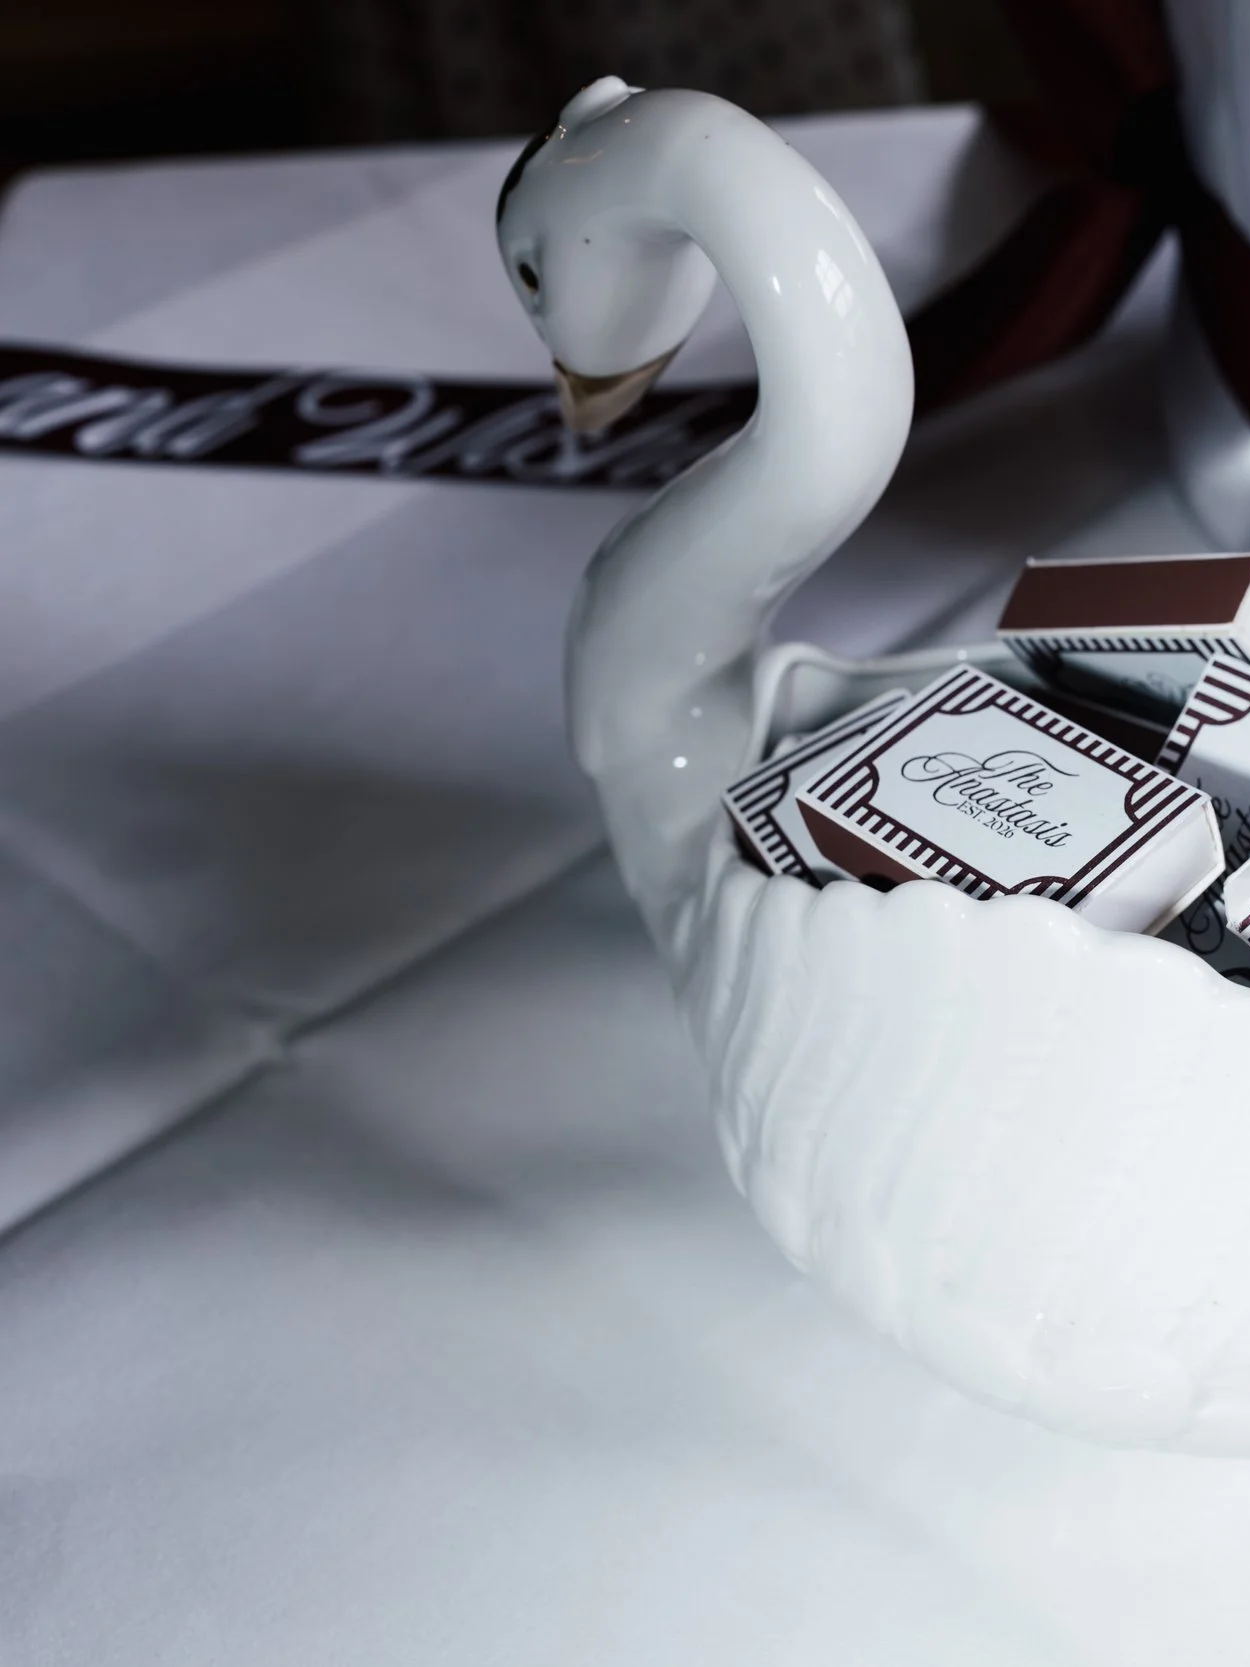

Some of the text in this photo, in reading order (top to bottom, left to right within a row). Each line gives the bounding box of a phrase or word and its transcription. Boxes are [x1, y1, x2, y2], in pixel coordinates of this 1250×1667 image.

[978, 750, 1080, 796] The
[901, 752, 1073, 848] Anastasis
[956, 800, 1016, 839] EST. 2026
